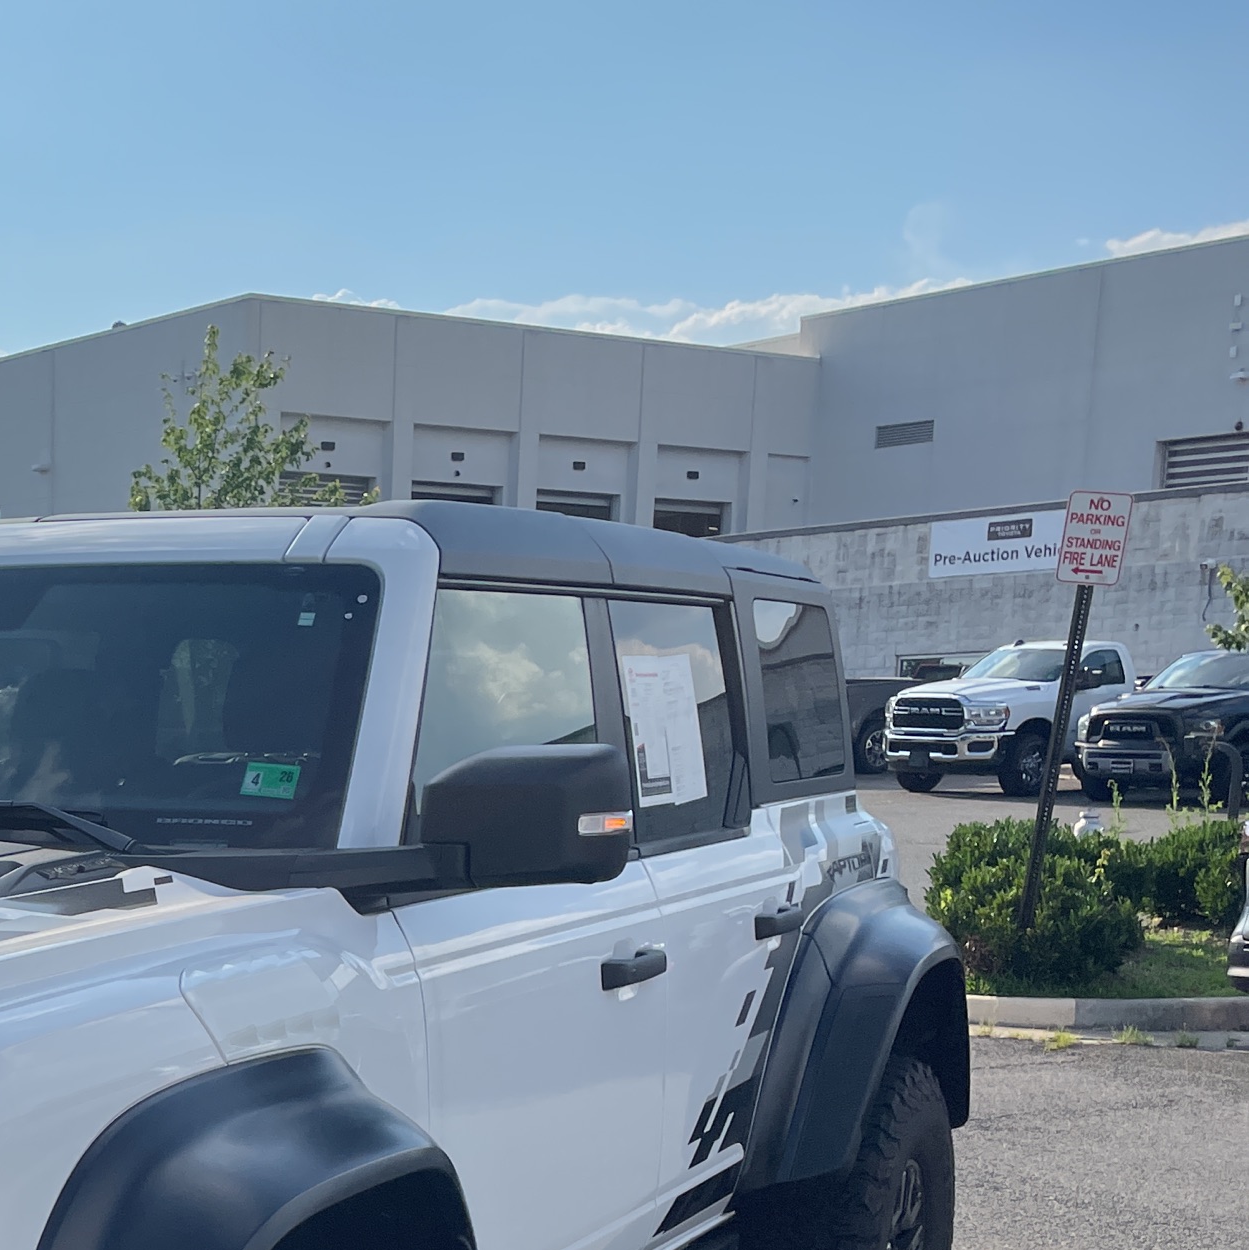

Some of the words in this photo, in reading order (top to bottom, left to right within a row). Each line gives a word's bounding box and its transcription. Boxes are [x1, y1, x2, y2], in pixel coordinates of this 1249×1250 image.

[1089, 498, 1112, 511] NO
[1069, 512, 1126, 527] PARKING
[1066, 536, 1121, 552] STANDING
[933, 547, 1019, 567] Pre-Auction
[1063, 551, 1087, 566] FIRE
[1090, 552, 1119, 568] LANE
[1109, 724, 1147, 733] RAM
[251, 772, 261, 787] 4
[156, 818, 253, 826] BRONCO
